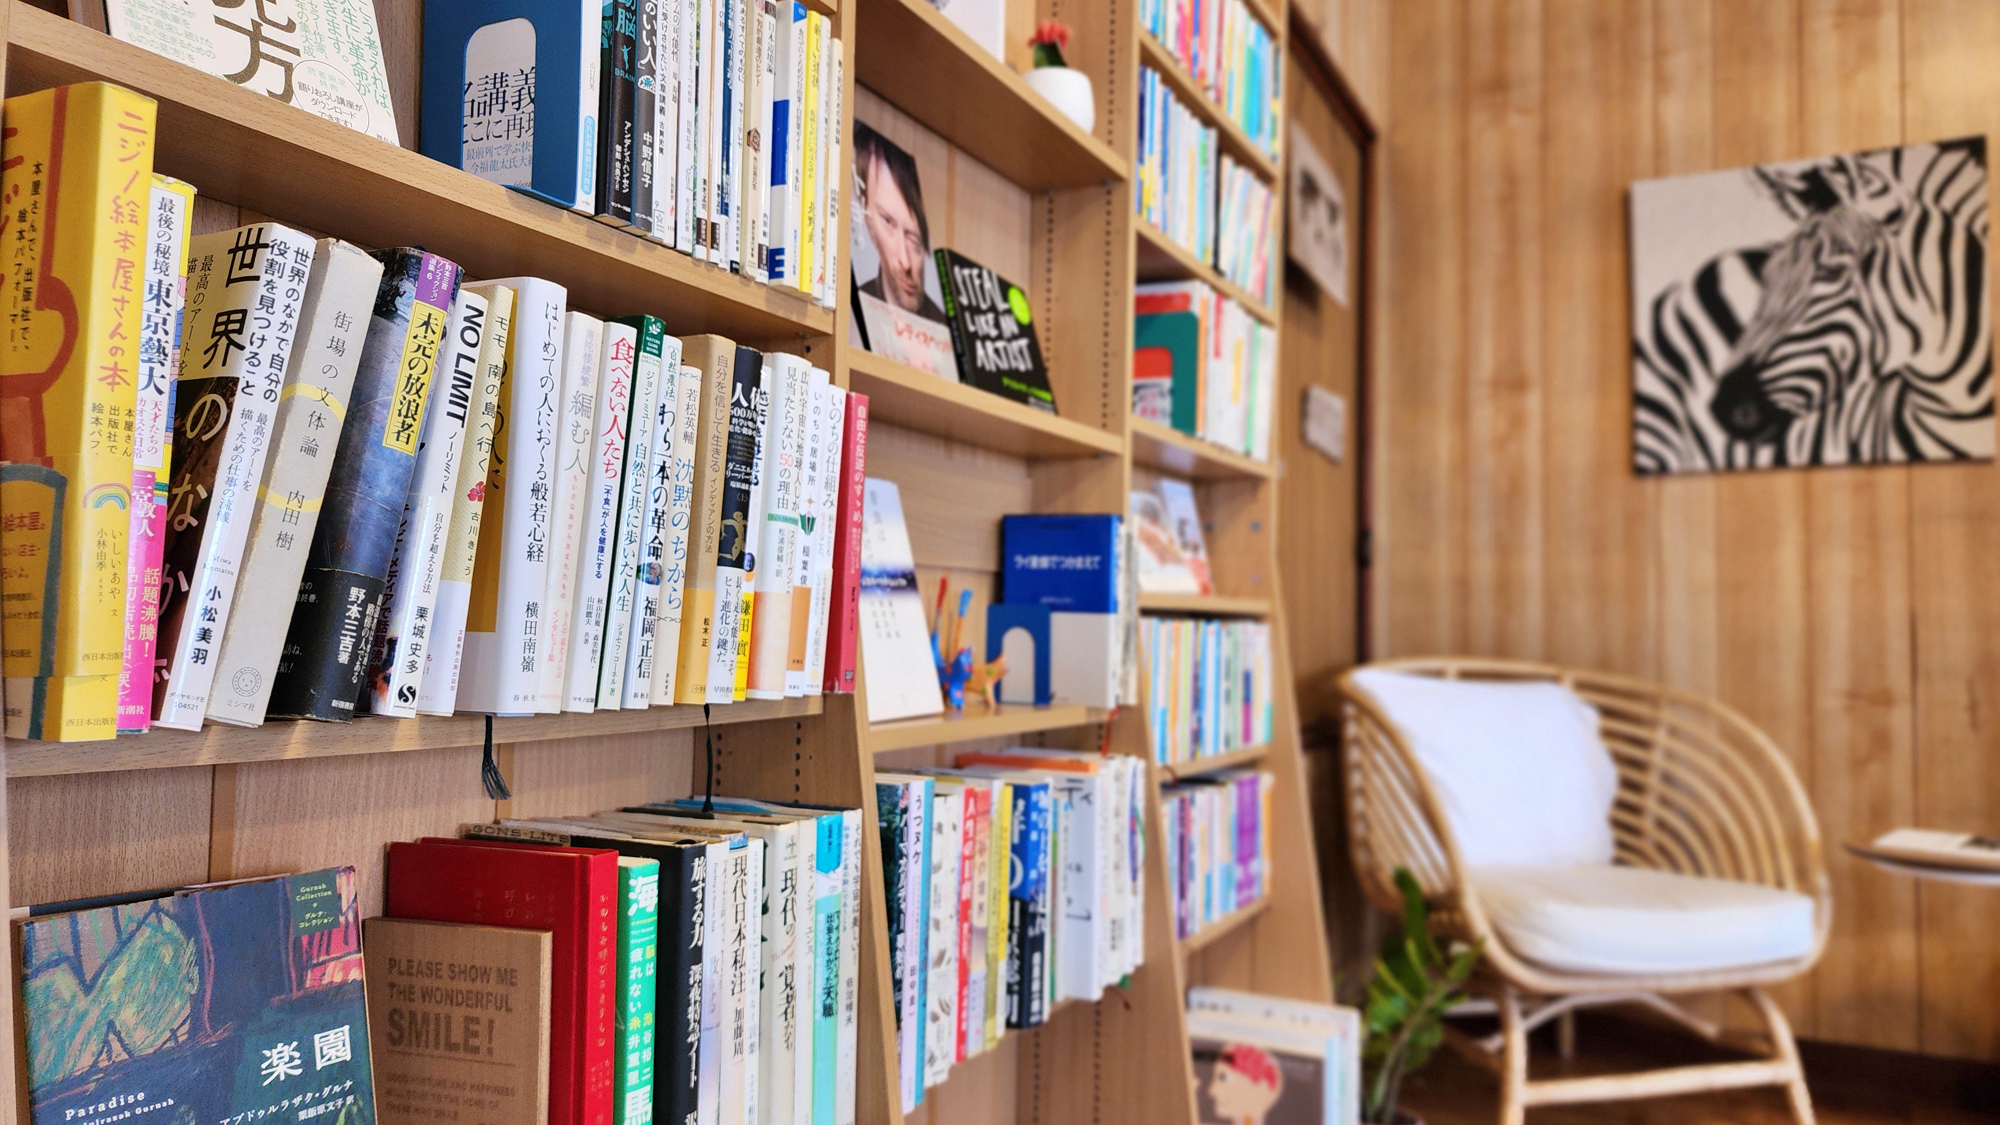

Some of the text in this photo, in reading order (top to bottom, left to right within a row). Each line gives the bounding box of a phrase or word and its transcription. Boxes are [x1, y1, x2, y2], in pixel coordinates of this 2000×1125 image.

[641, 131, 653, 188] 中野信子
[97, 110, 148, 393] ニジノ絵本屋さんの本
[152, 196, 176, 278] 最後の秘境
[241, 238, 292, 397] 役割を見つけること
[262, 246, 311, 403] 世界のなかで自分の
[953, 264, 1010, 312] STEAL
[138, 278, 174, 397] 東京藝大
[446, 303, 485, 429] NO LIMIT
[975, 336, 1034, 374] ARTIST
[299, 310, 354, 459] 街場の文体論
[600, 337, 635, 480] 食べない人たち
[710, 355, 729, 474] 自分を信じて生きる
[146, 399, 163, 456] 天才たちの
[242, 412, 269, 492] 最高のアートを
[440, 431, 458, 494] ノーリミット
[525, 301, 559, 564] はじめての人におくる般若心経
[646, 402, 676, 562] わら一本の革命
[704, 477, 718, 554] インディアンの方法
[615, 442, 648, 613] 自然と共に歩いた人生
[667, 457, 695, 610] 沈黙のちから
[190, 585, 222, 666] 小松美羽
[520, 600, 540, 674] 横田南嶺
[637, 595, 658, 679] 福岡正信
[387, 956, 519, 987] PLEASE SHOW ME
[387, 981, 514, 1013] THE WONDERFUL
[260, 1024, 352, 1087] 楽園
[386, 1006, 495, 1056] SMILE!
[65, 1091, 146, 1121] Paradise
[134, 1098, 175, 1115] Gurnah
